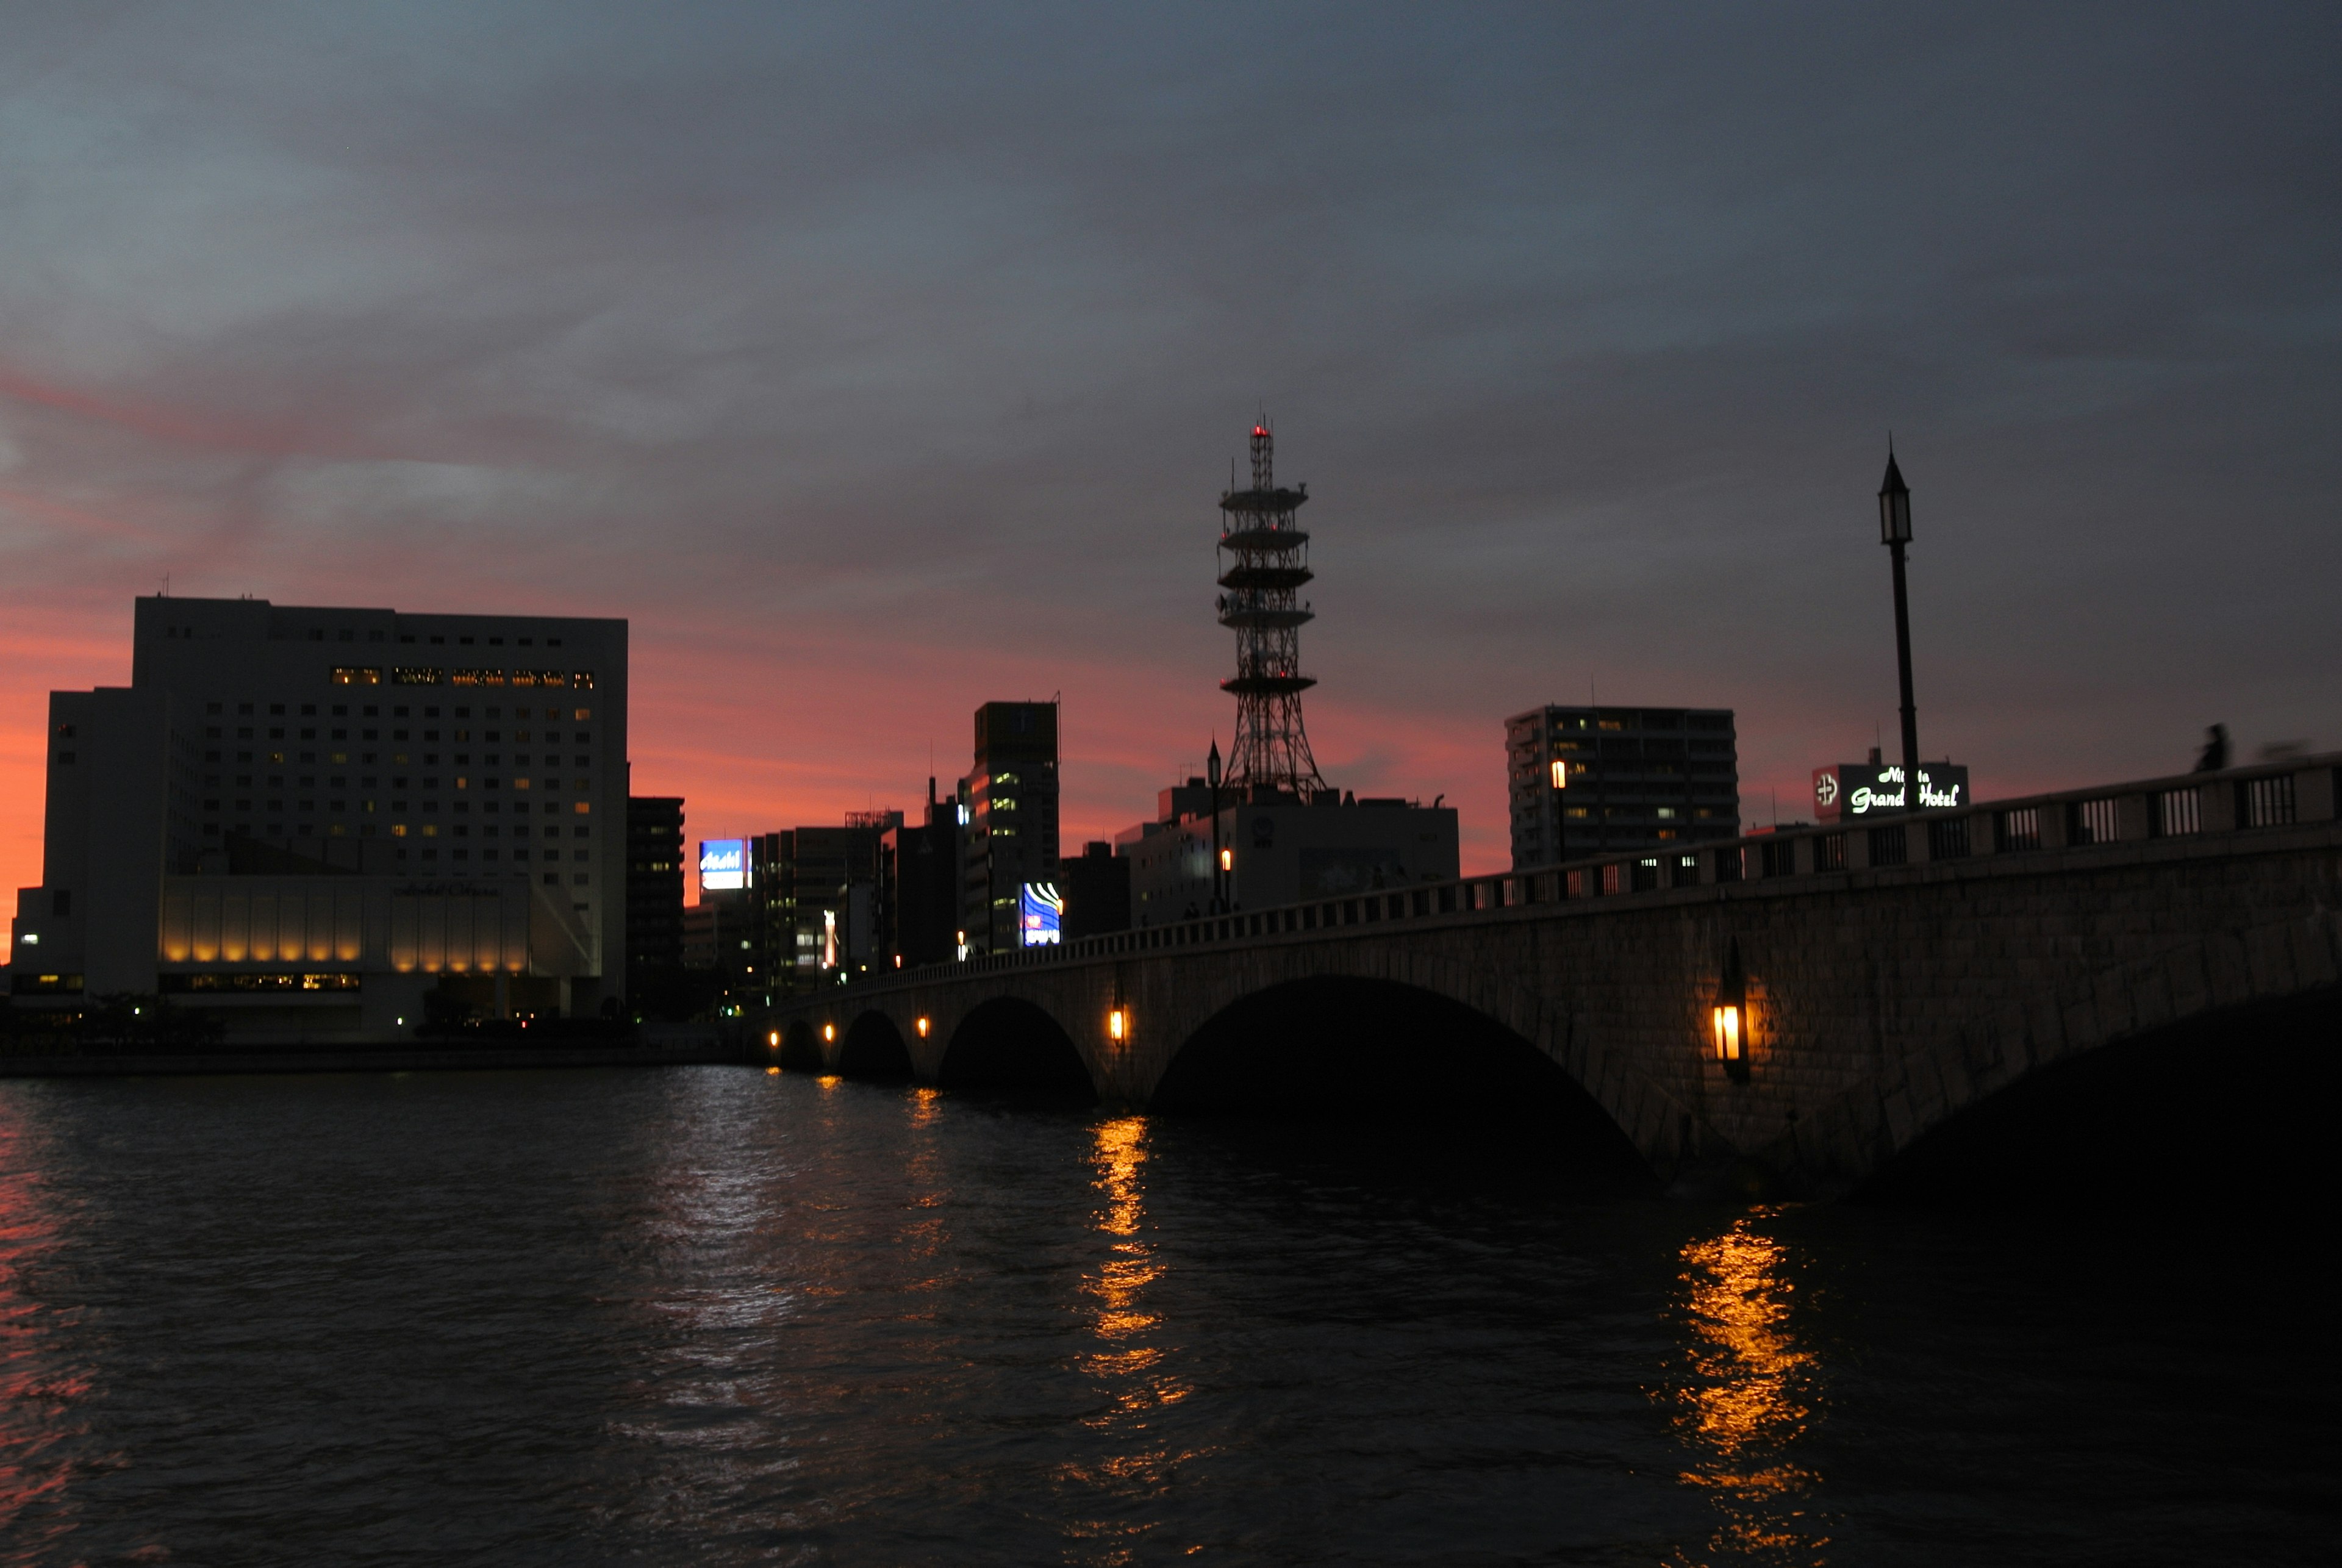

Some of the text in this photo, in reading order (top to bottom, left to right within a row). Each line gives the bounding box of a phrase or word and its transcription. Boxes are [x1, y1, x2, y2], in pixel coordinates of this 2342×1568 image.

[1851, 782, 1960, 814] Grand Hotel
[700, 850, 740, 870] Asahi
